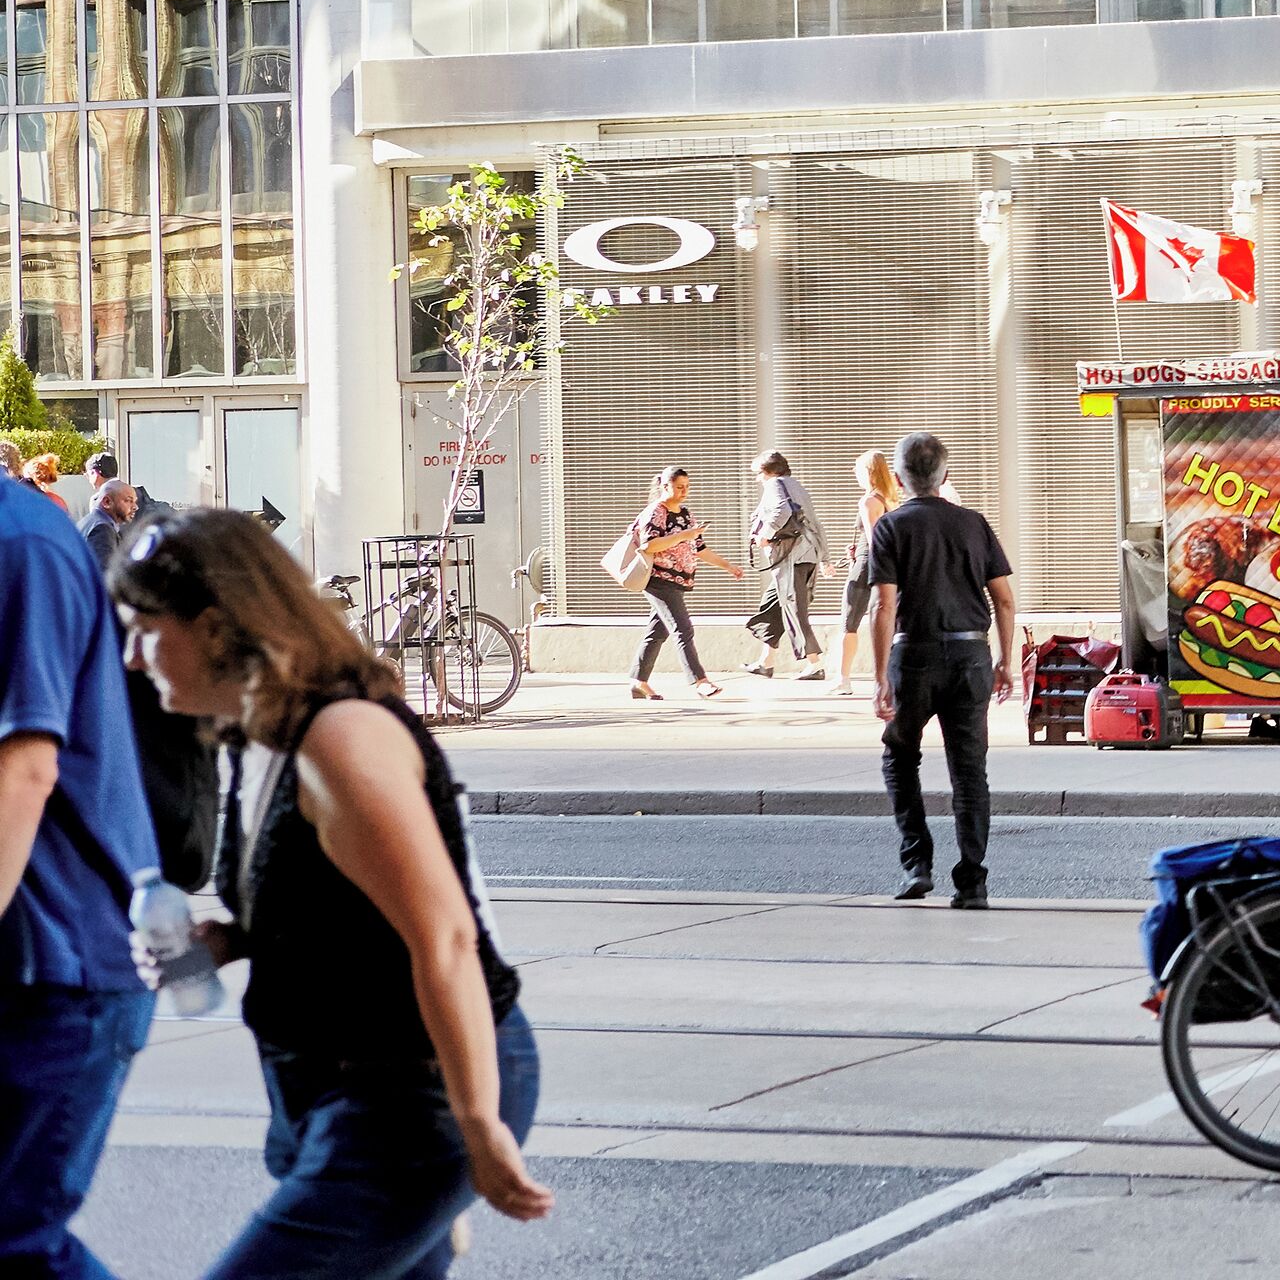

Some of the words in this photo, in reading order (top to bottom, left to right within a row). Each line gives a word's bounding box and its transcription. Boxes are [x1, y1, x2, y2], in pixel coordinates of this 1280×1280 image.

[1086, 367, 1124, 385] HOT
[1168, 397, 1241, 410] PROUDLY
[423, 456, 439, 466] DO
[1181, 452, 1270, 519] HOT
